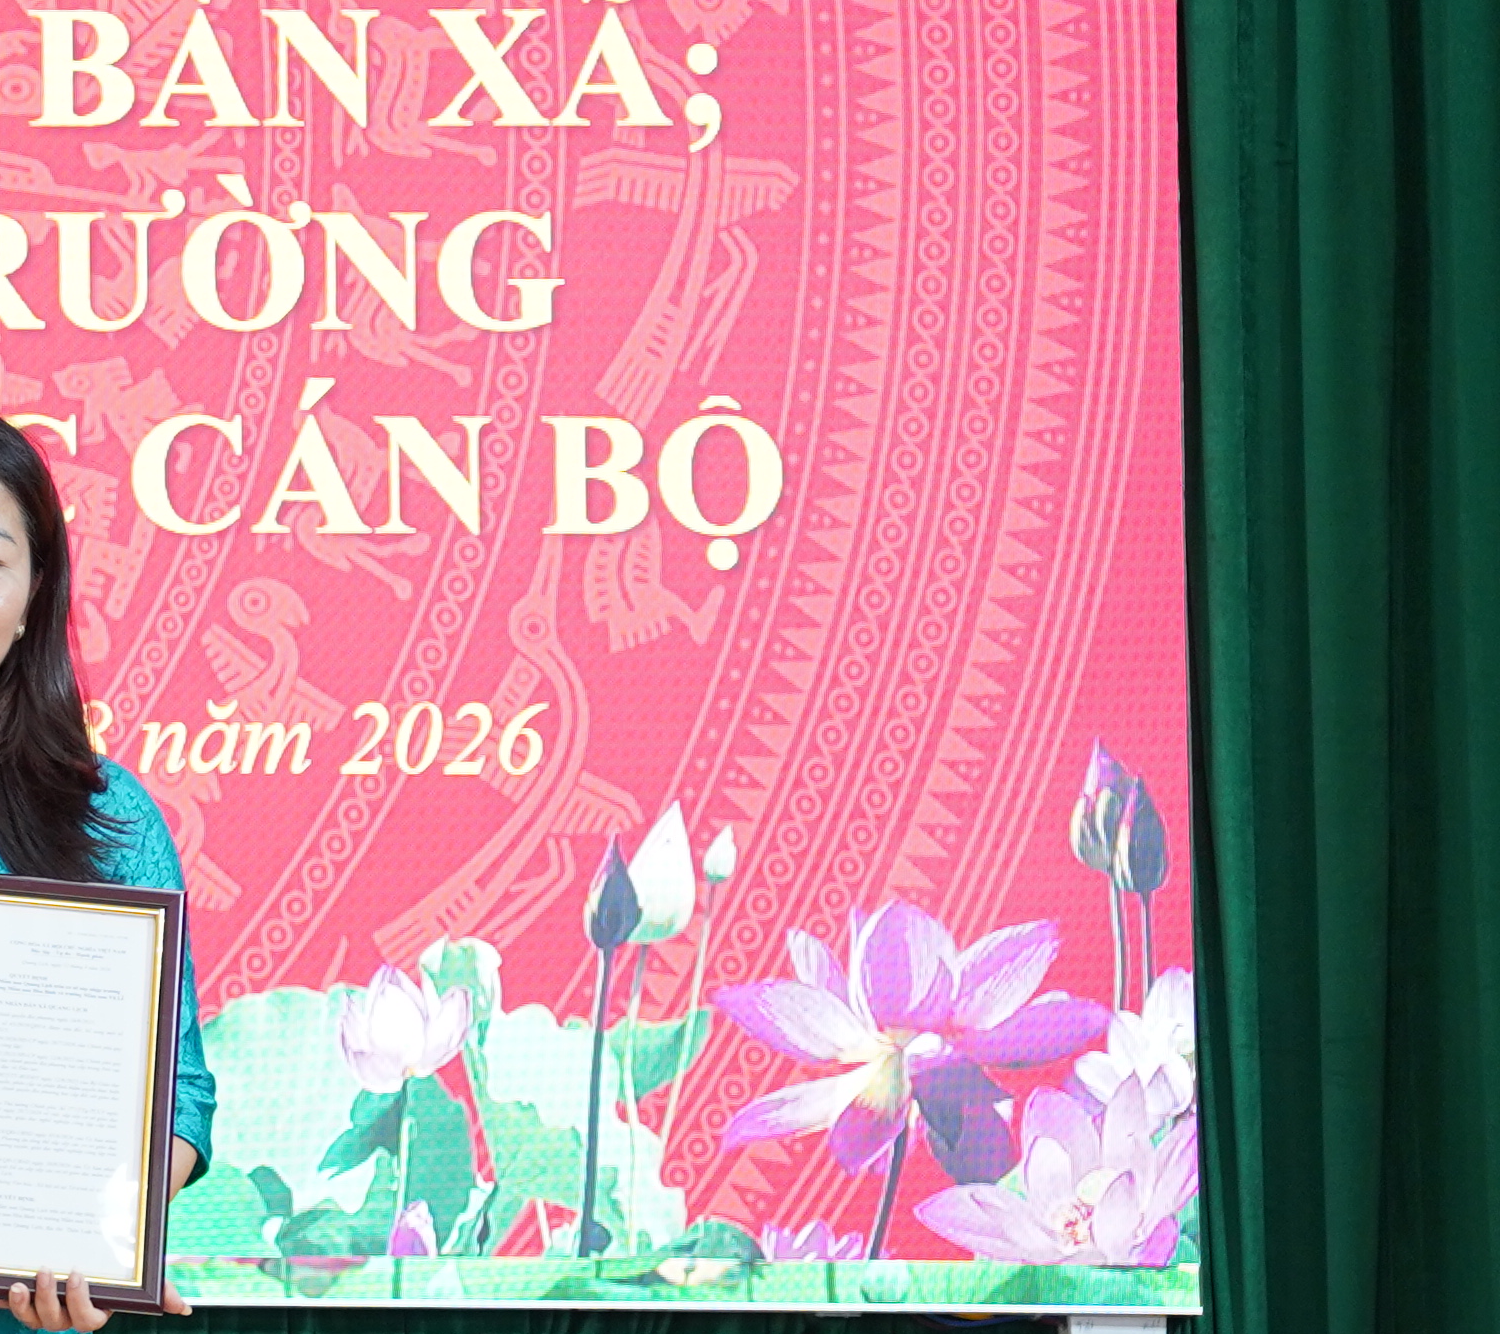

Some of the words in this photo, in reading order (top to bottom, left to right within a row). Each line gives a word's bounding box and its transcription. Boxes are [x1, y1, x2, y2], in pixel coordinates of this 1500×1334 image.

[131, 376, 493, 537] CÁN
[540, 394, 784, 572] BỘ
[138, 698, 312, 776] năm
[339, 700, 550, 777] 2026
